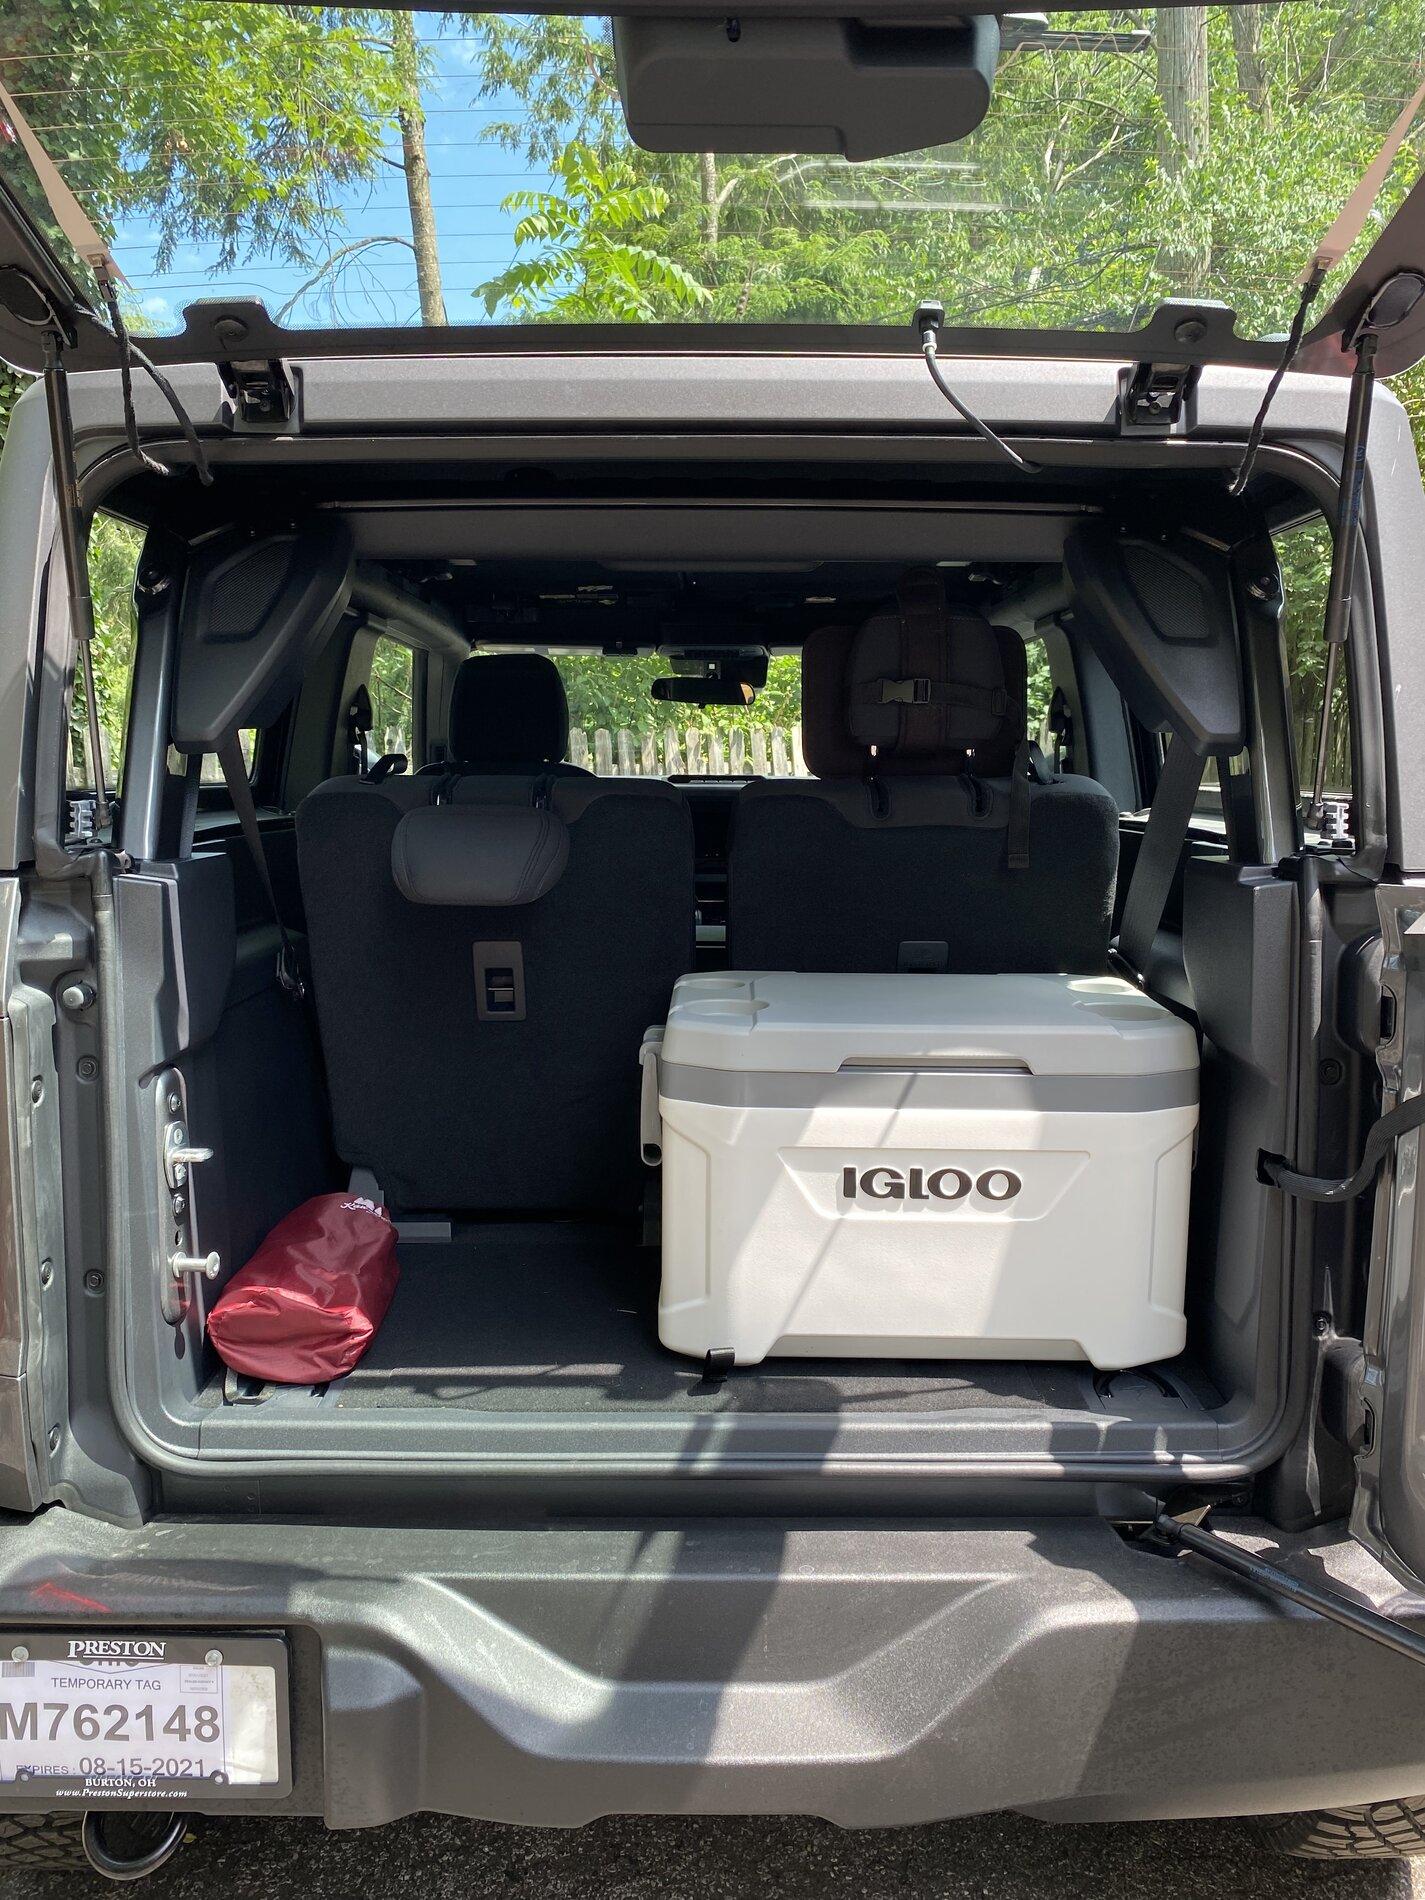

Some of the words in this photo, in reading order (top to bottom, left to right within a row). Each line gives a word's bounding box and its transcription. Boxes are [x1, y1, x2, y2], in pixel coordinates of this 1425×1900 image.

[843, 1166, 1022, 1201] IGLOO
[67, 1640, 167, 1658] PRESTON
[51, 1677, 132, 1690] TEMPORARY
[135, 1679, 162, 1691] TAG
[0, 1702, 220, 1743] M762148
[79, 1757, 205, 1777] 08-15-2021
[85, 1778, 135, 1788] BURTON,
[138, 1779, 157, 1787] OH
[55, 1788, 188, 1799] www.PrestonSuperstore.com
